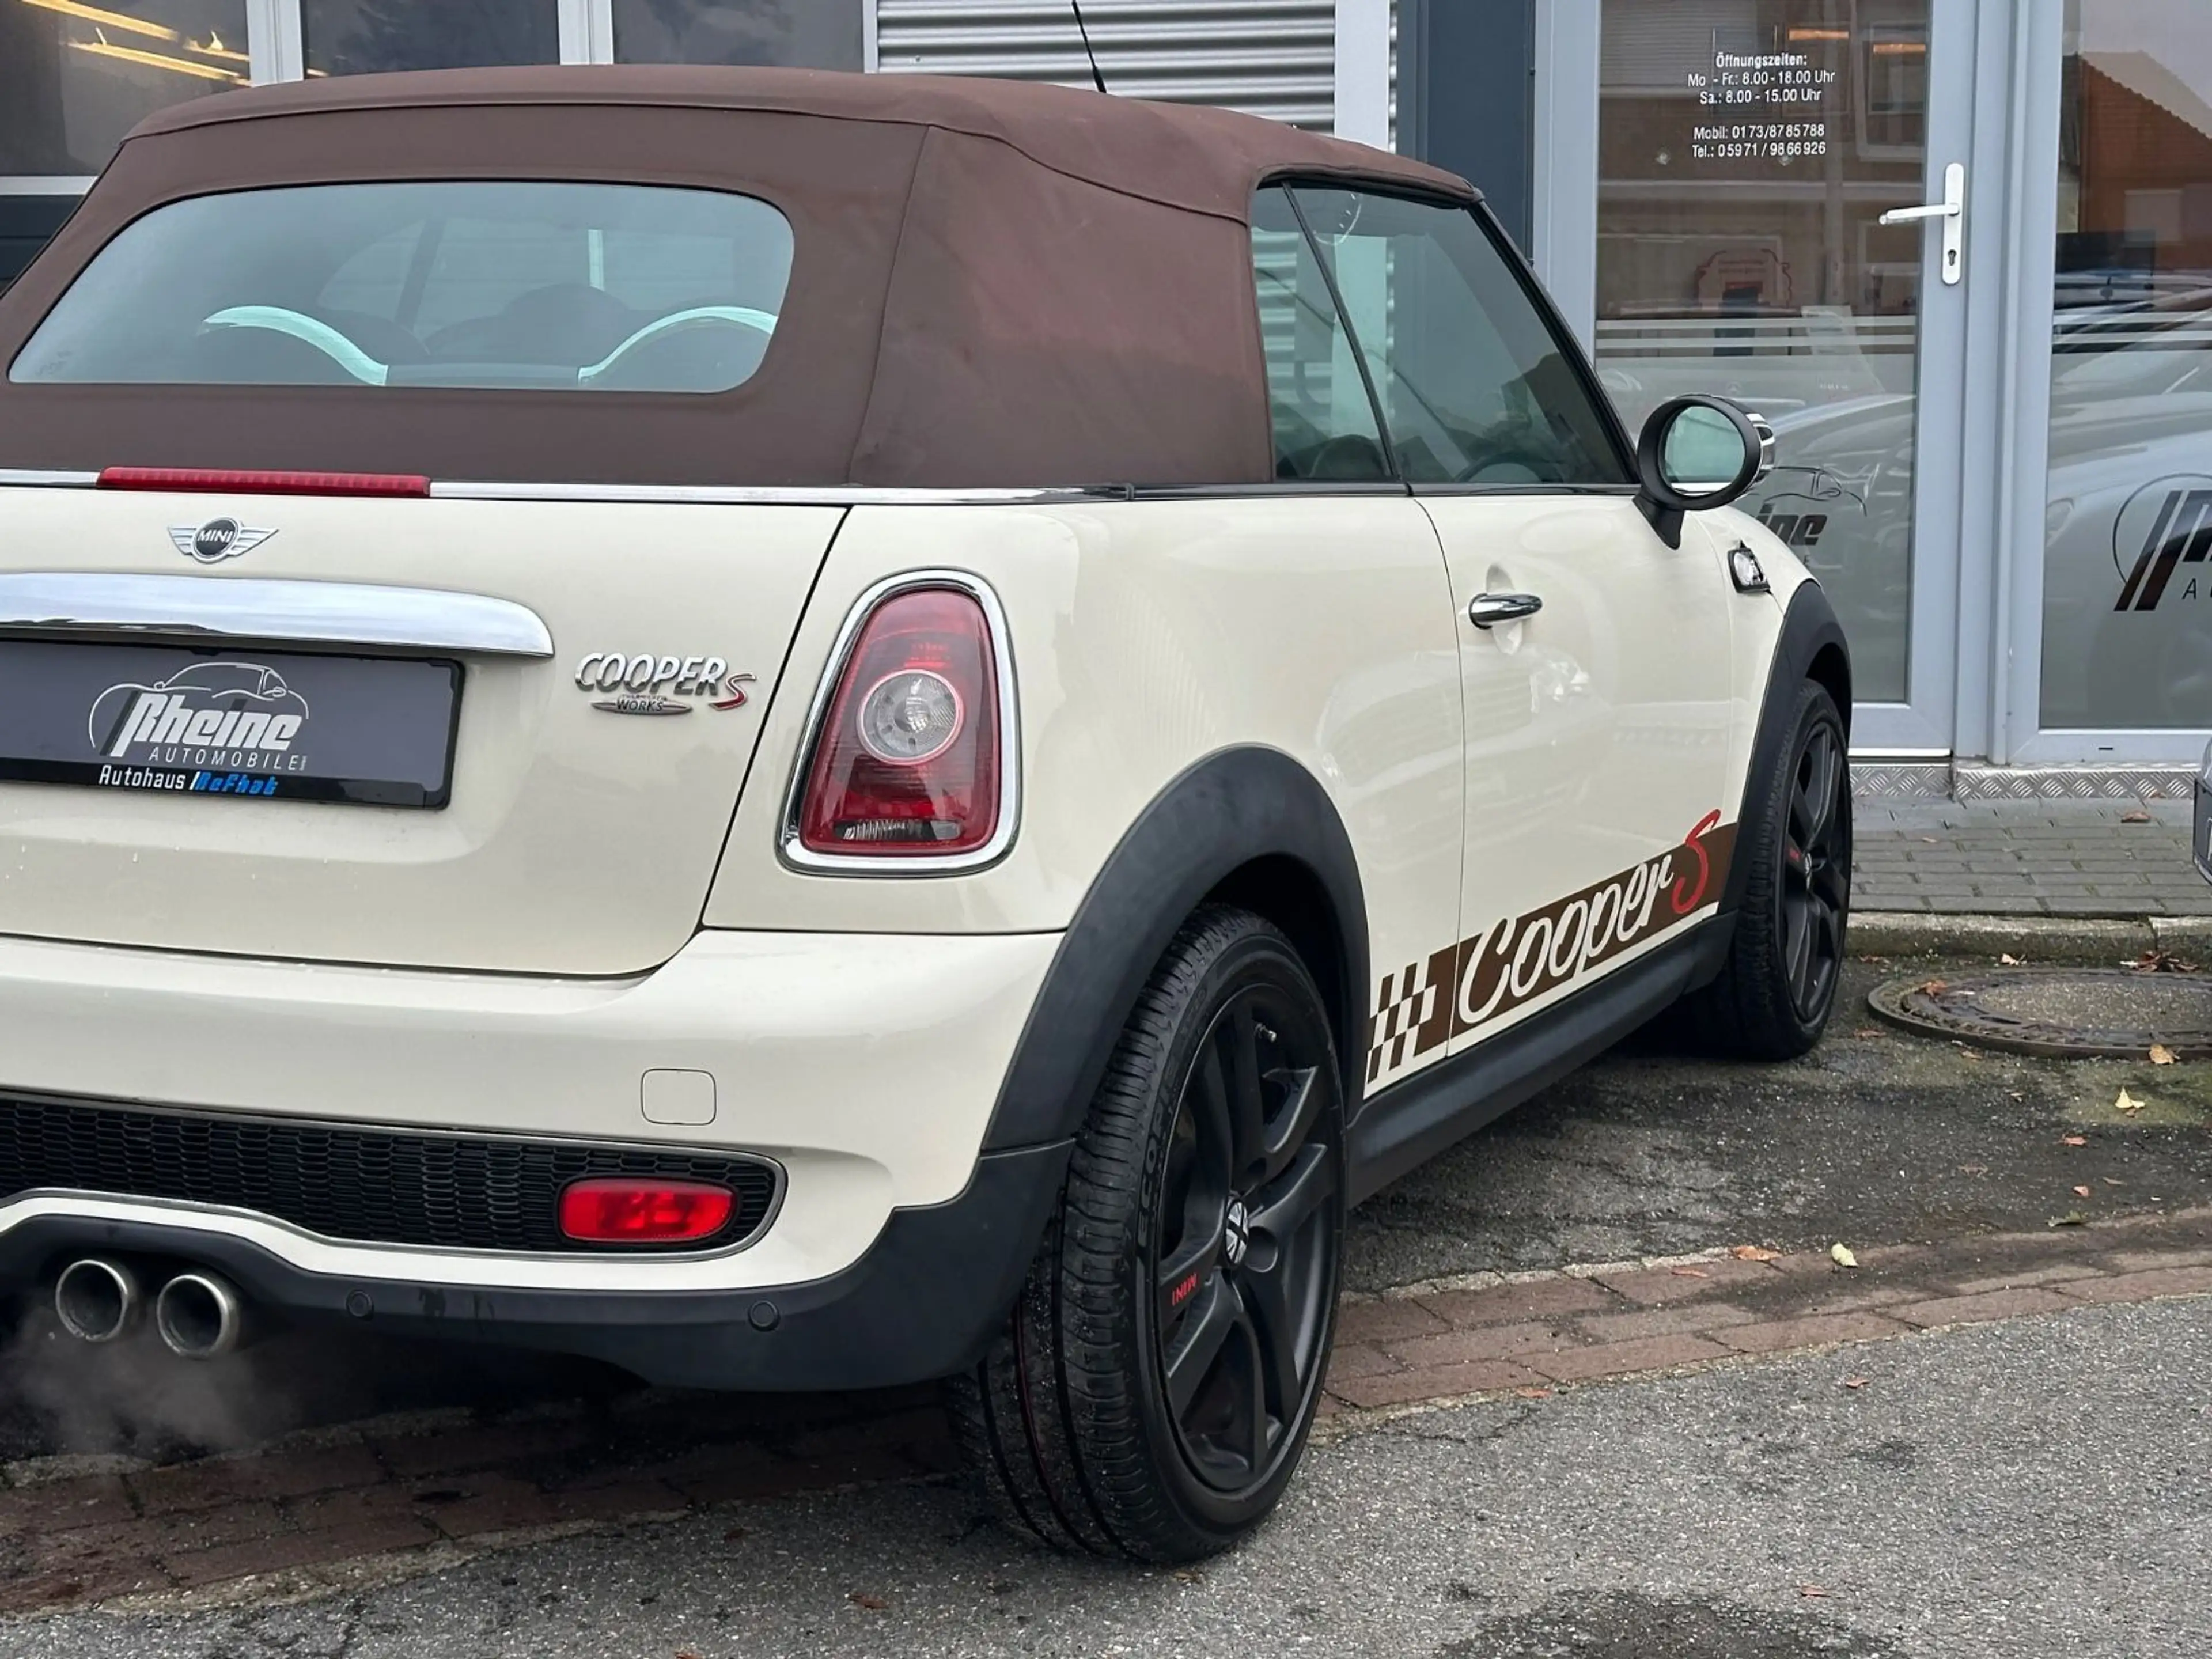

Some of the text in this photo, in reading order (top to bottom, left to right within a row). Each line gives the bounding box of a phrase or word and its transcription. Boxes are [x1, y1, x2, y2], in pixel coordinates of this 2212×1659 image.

[1716, 51, 1808, 69] Öffnungszeiten:
[1688, 73, 1706, 86] Mo
[1722, 73, 1738, 85] Fr.:
[1742, 71, 1768, 85] 8.00
[1778, 70, 1810, 84] 18.00
[1815, 70, 1835, 83] Uhr
[1700, 91, 1722, 104] Sa.:
[1726, 90, 1751, 103] 8.00
[1764, 89, 1797, 103] 15.00
[1801, 88, 1821, 101] Uhr
[1694, 126, 1728, 139] Mobil:
[1692, 145, 1714, 157] Tel.:
[198, 529, 233, 542] MINI
[575, 653, 757, 711] COOPER S
[616, 700, 664, 712] WORKS
[110, 692, 302, 758] Rheine
[148, 748, 298, 771] AUTOMOBILE
[99, 764, 186, 789] Autohaus
[1459, 809, 1721, 1024] Cooper S
